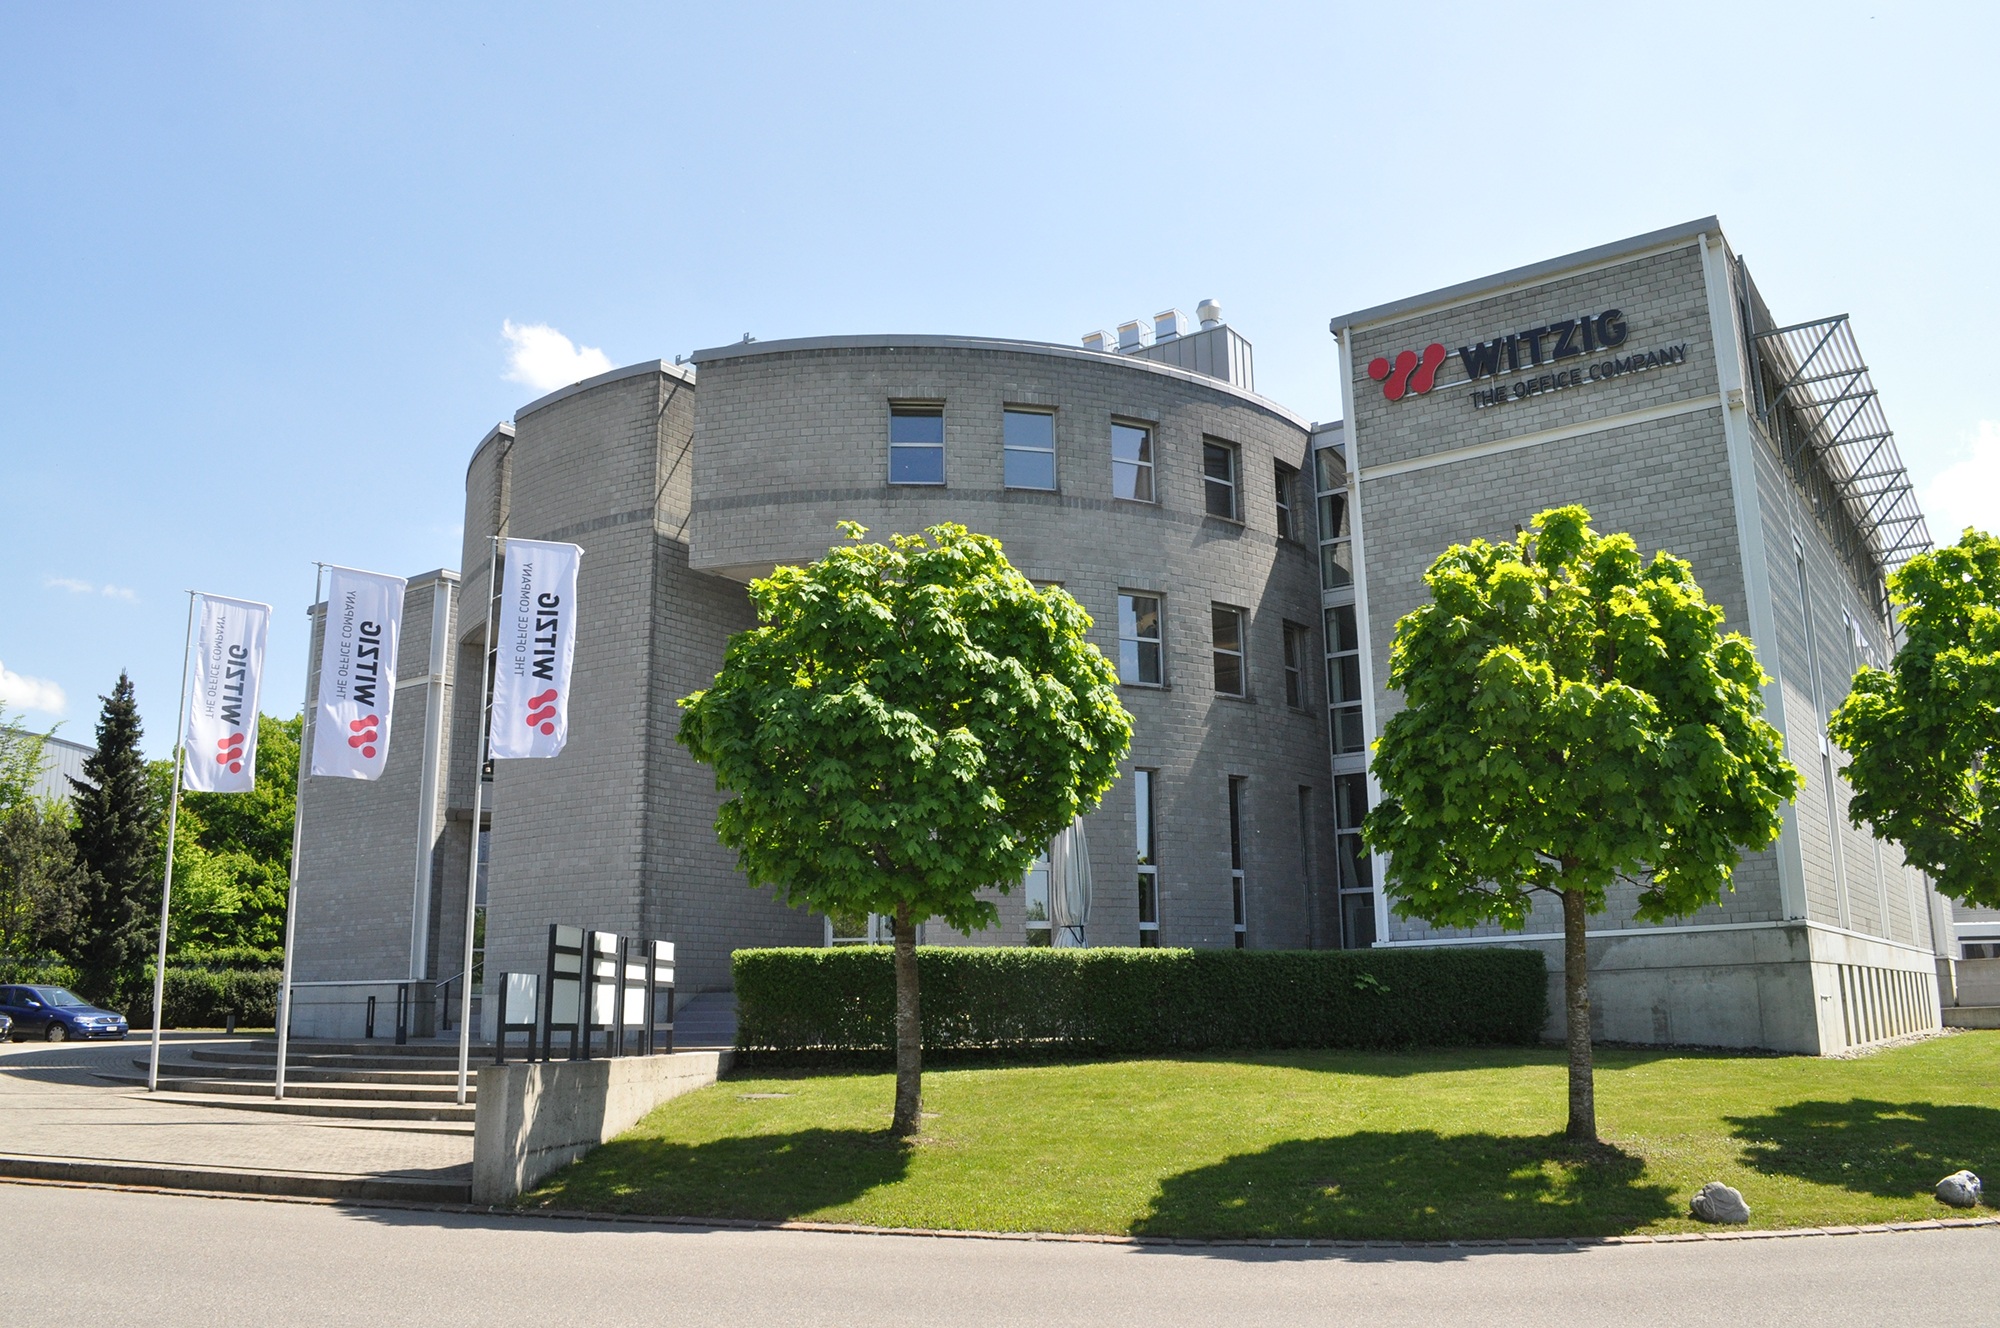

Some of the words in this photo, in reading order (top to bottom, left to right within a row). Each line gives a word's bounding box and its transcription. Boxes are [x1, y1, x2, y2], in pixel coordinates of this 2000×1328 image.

[1458, 309, 1628, 380] WITZIG
[1470, 386, 1507, 408] THE
[1514, 368, 1582, 399] OFFICE
[1589, 343, 1688, 382] COMPANY
